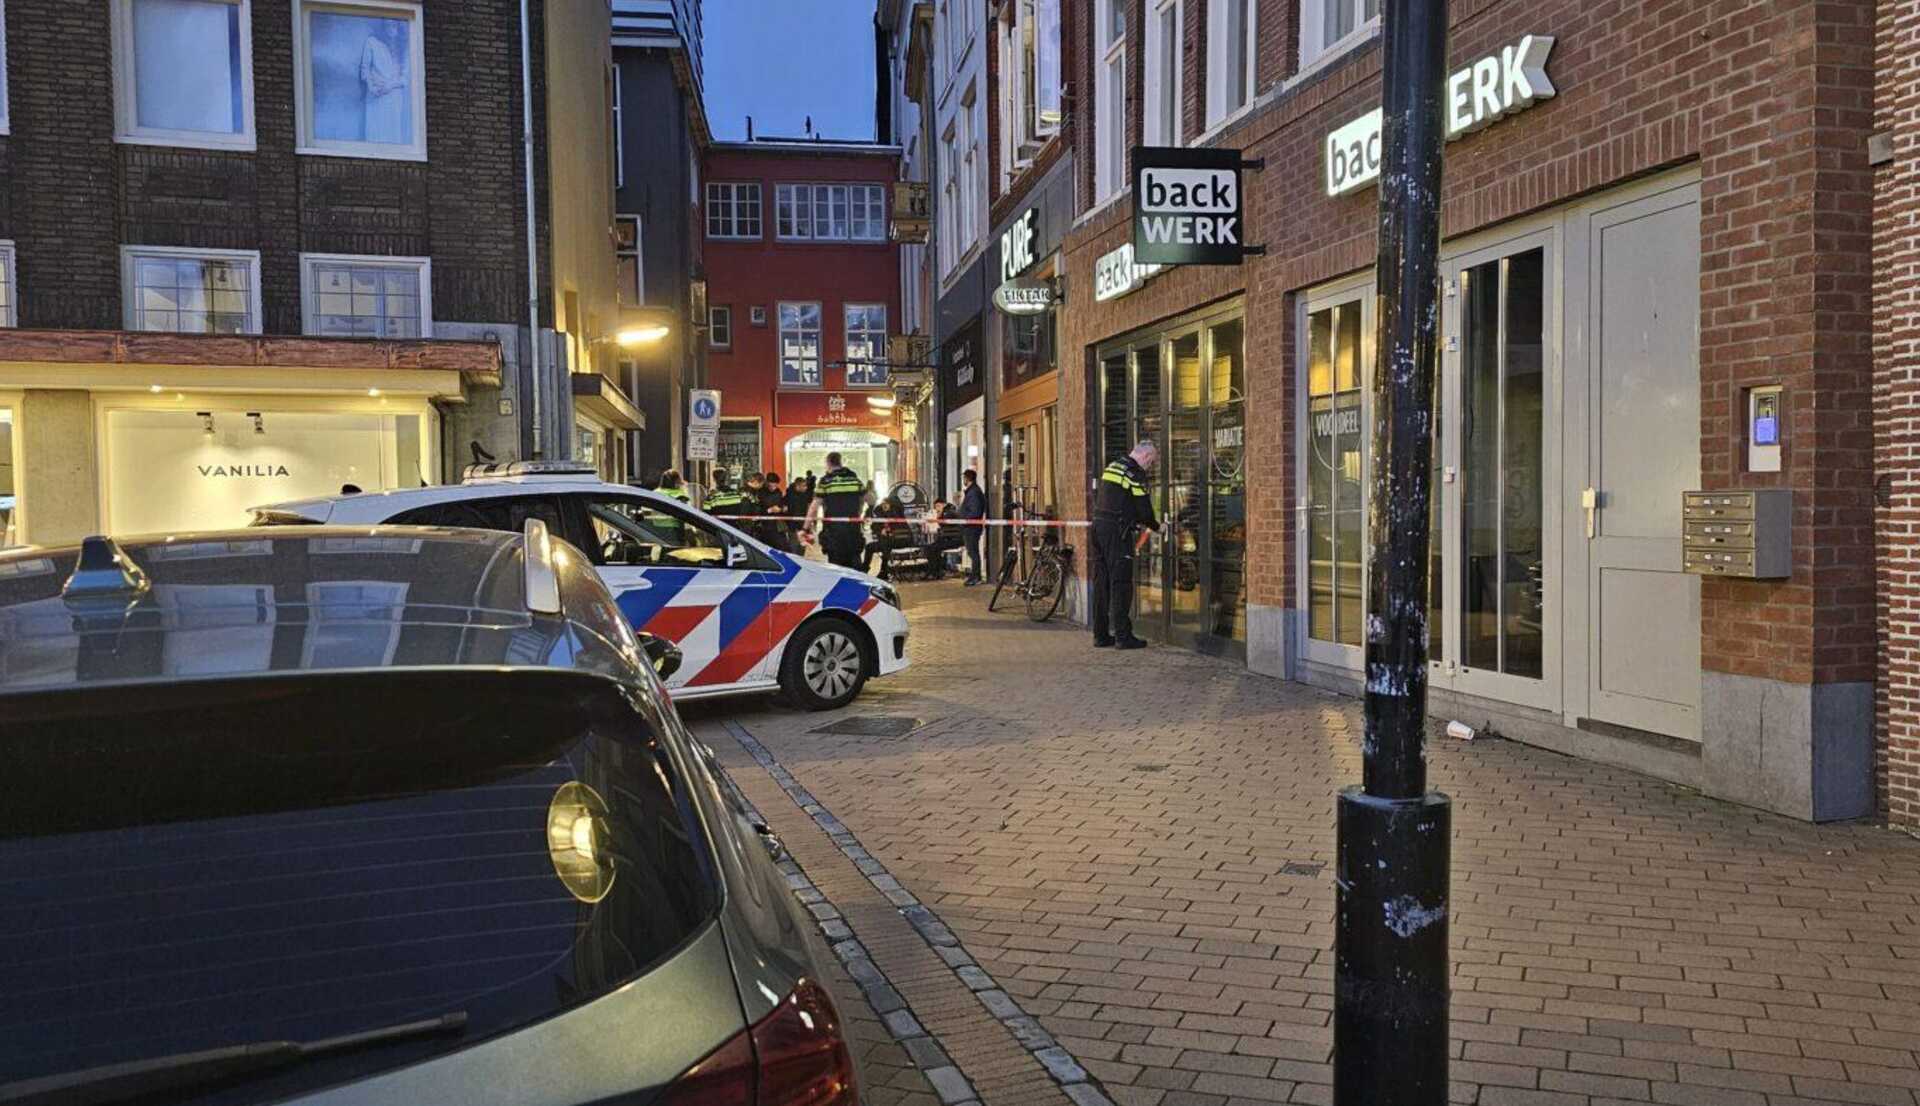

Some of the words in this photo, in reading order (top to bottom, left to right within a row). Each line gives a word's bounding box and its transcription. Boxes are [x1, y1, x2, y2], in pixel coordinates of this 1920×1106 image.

[1331, 131, 1380, 187] bac
[1449, 34, 1534, 133] ERK
[1146, 172, 1232, 208] back
[1002, 208, 1034, 284] PURE
[1141, 216, 1238, 245] WERK
[1097, 250, 1128, 296] back
[197, 464, 290, 477] VANILIA
